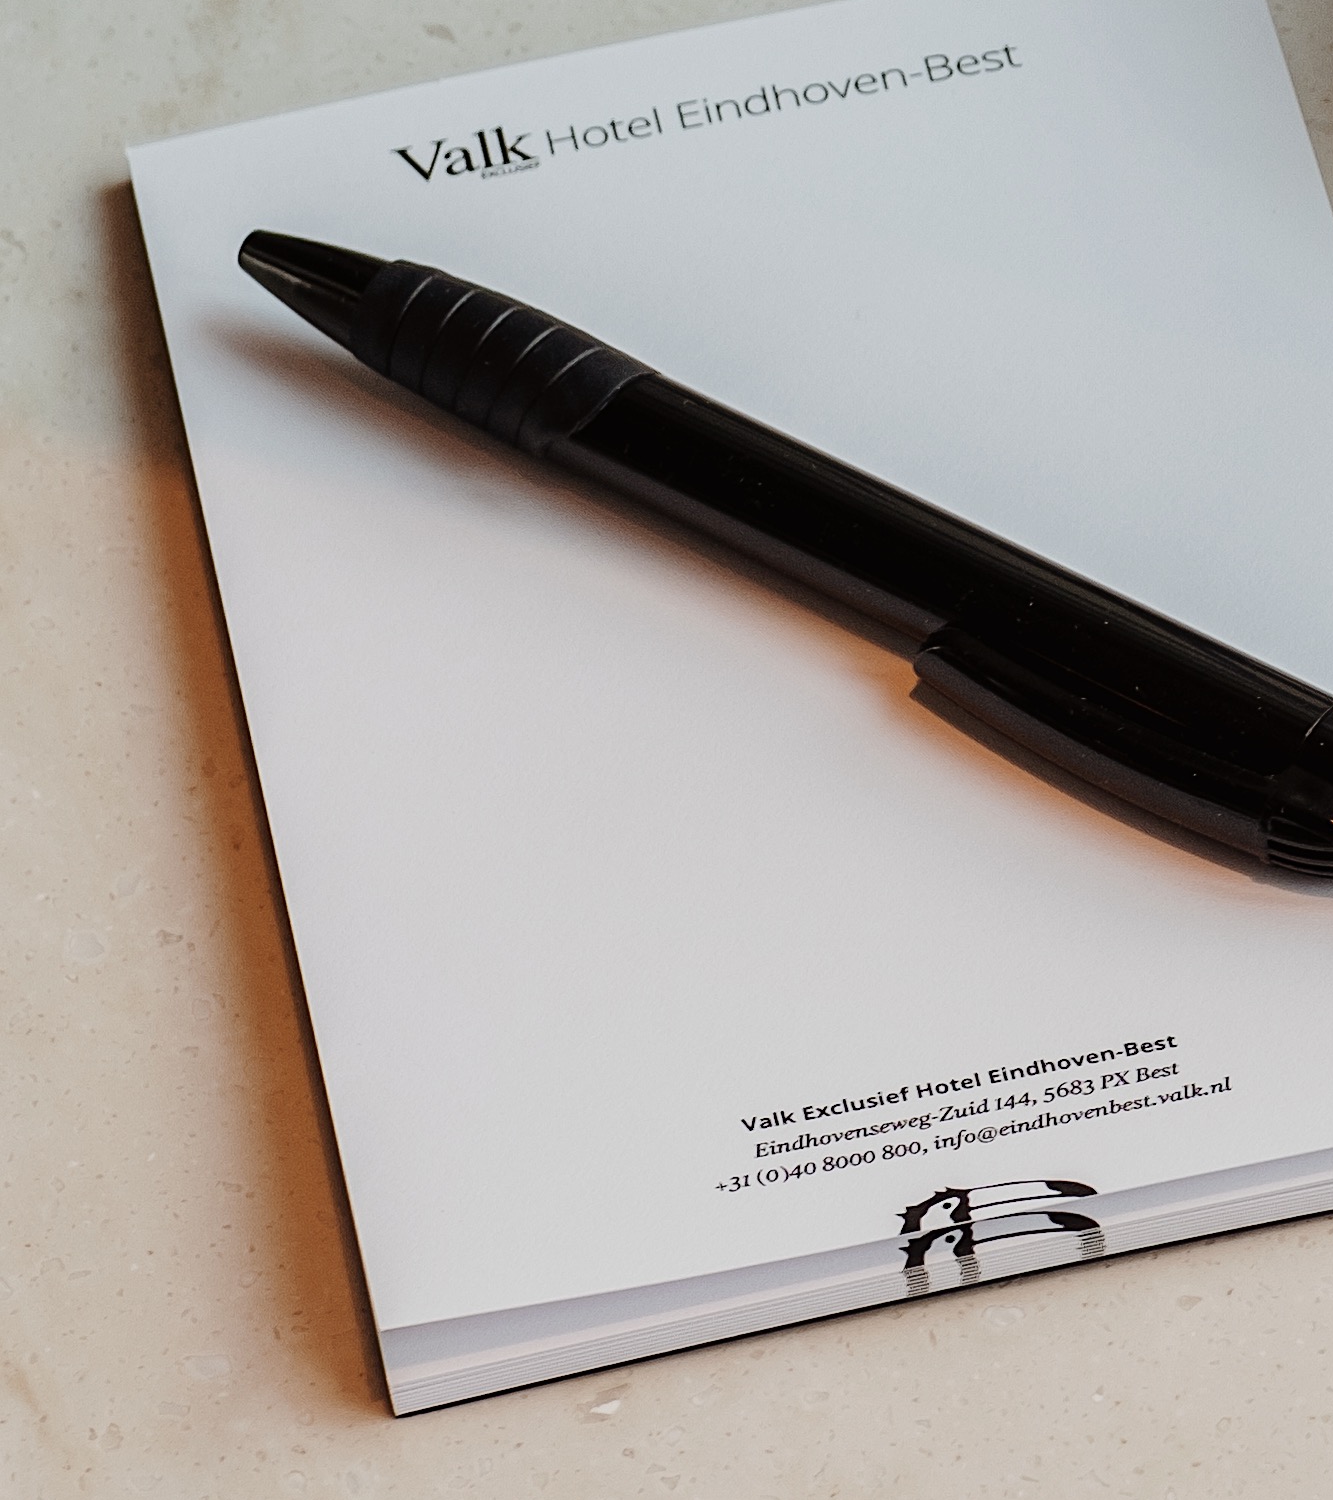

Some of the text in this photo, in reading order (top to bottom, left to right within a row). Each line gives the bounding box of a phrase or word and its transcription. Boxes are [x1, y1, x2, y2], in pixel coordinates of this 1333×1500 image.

[392, 44, 1022, 182] Valk Hotel Eindhoven-Best
[715, 1076, 1232, 1192] +31 (0)40 8000 800, info@eindhovenbest.valk.nl
[741, 1036, 1178, 1131] Valk Exclusief Hotel Eindhoven-Best
[756, 1063, 1179, 1158] Eindhovenseweg-Zuid 144, 5683 PX Best
